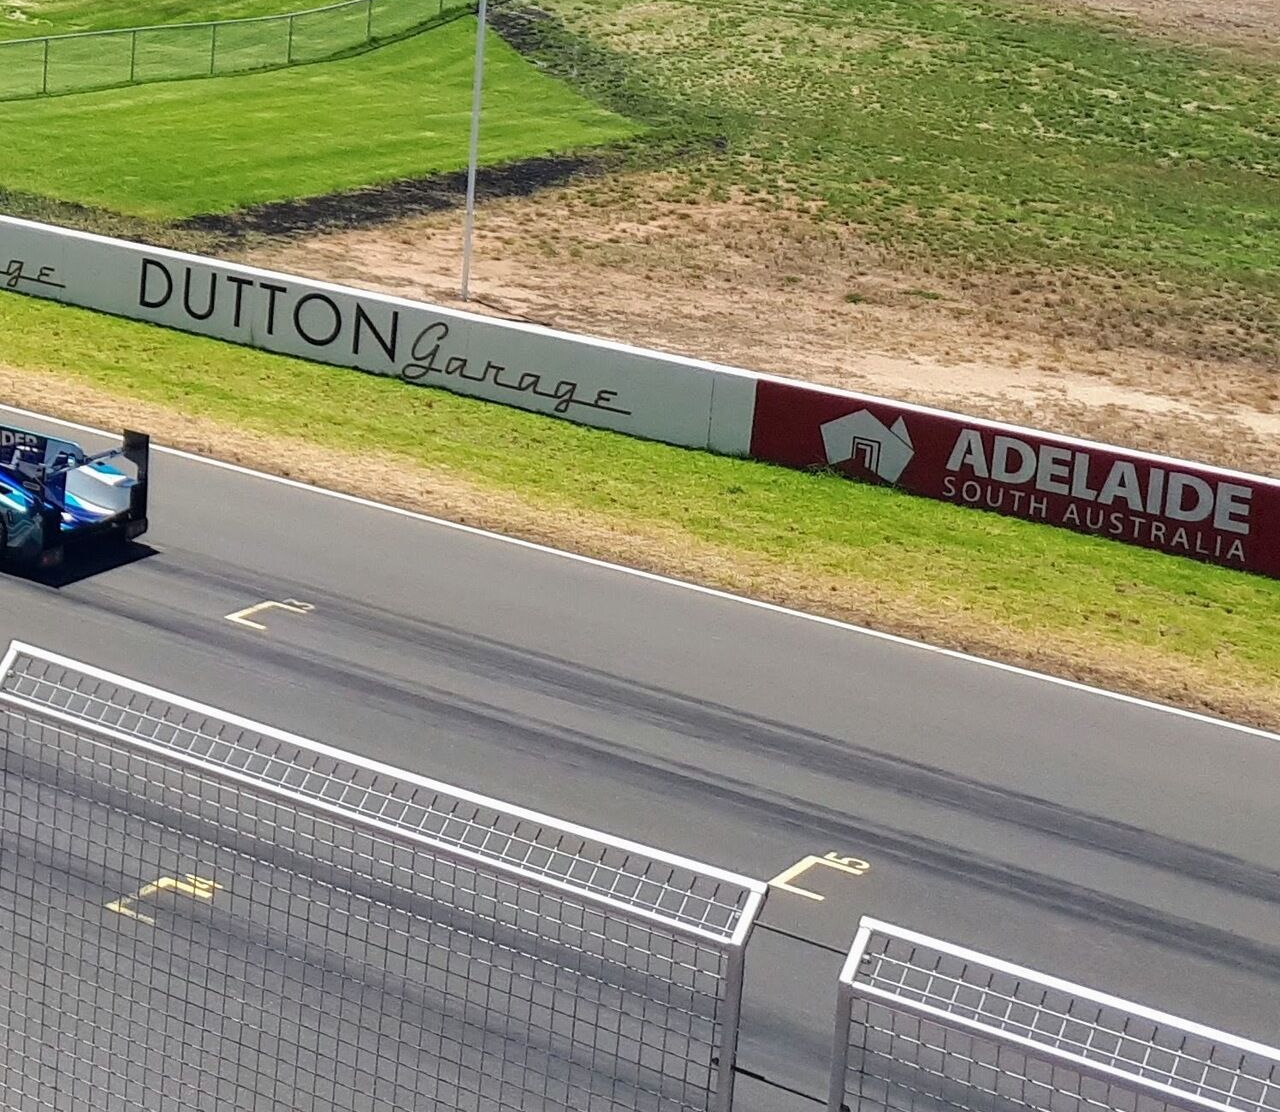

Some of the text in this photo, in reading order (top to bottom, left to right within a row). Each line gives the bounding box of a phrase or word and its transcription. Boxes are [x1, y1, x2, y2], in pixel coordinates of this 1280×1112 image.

[139, 258, 632, 414] DUTTON Garage
[941, 476, 1246, 562] SOUTH AUSTRALIA
[945, 428, 1253, 535] ADELAIDE
